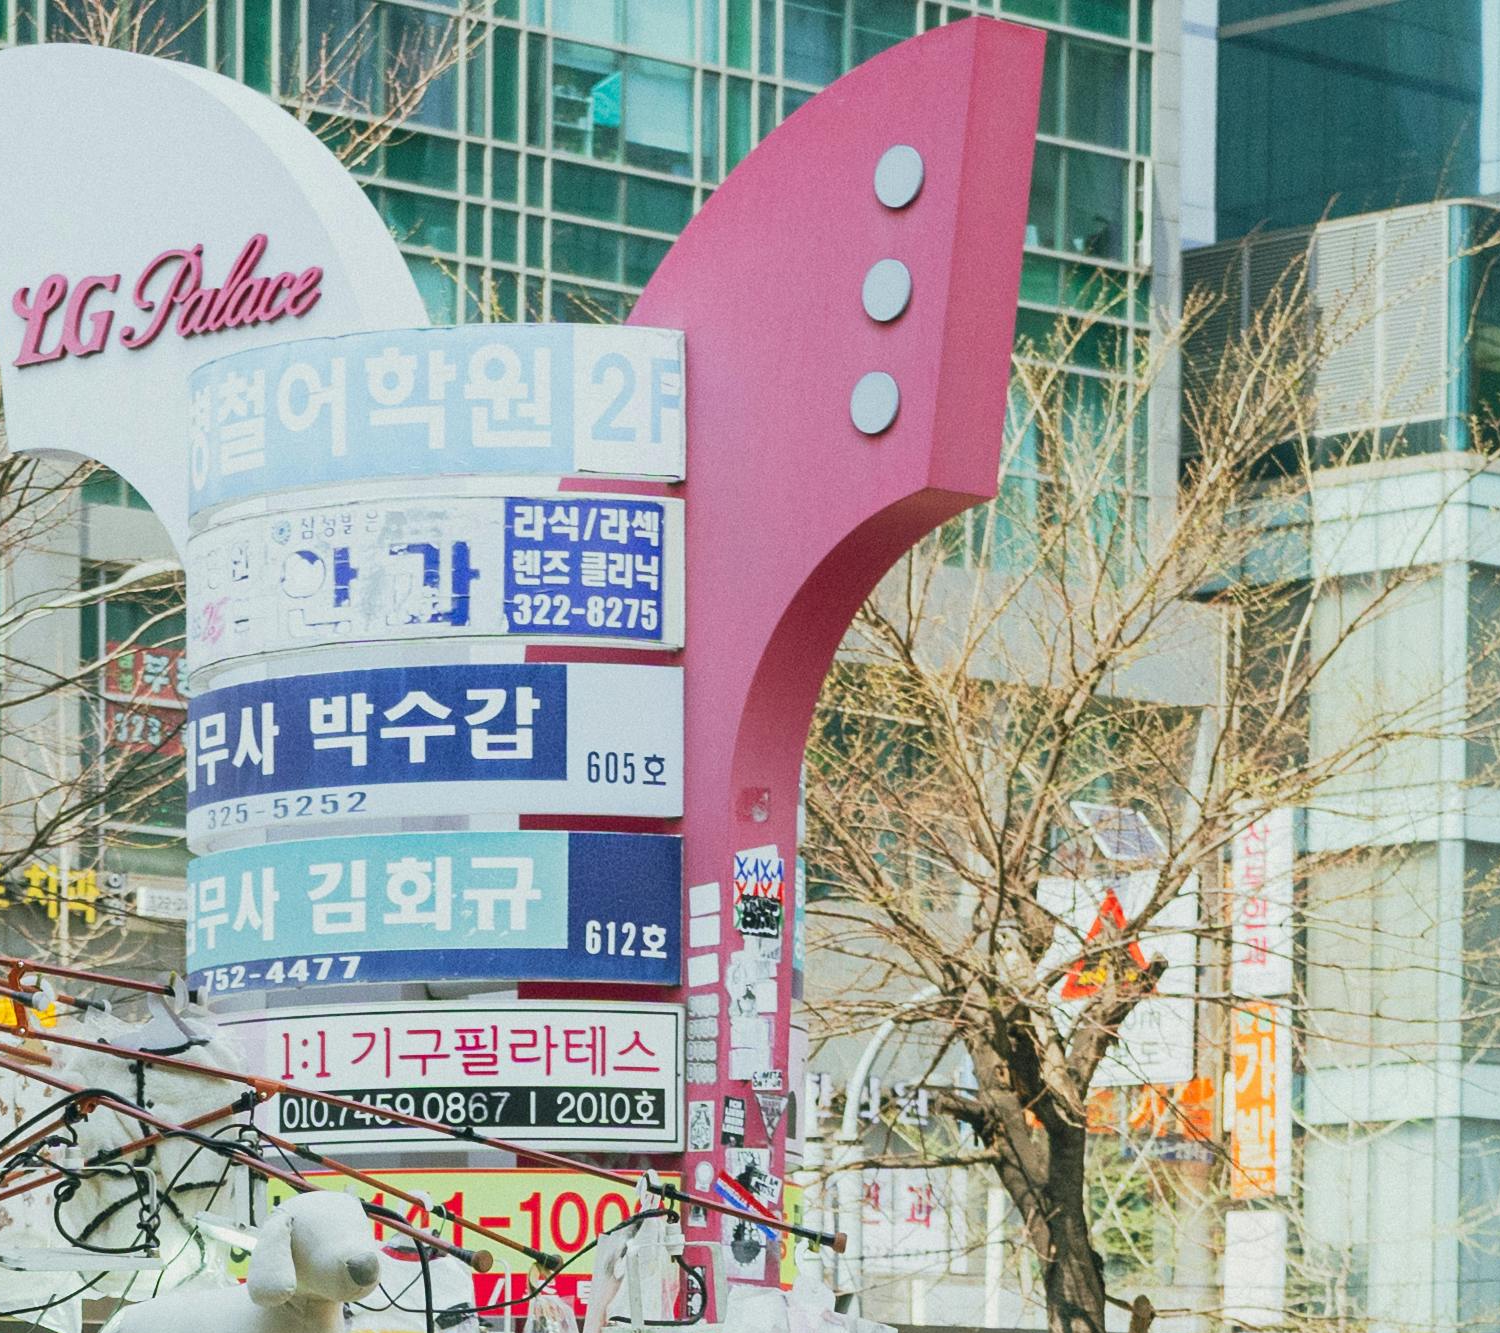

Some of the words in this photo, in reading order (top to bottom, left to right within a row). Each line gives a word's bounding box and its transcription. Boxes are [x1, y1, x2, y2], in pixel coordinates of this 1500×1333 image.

[10, 270, 122, 368] LG
[118, 232, 324, 349] Palace
[513, 505, 660, 547] 라식/라섹
[513, 549, 571, 588] 렌즈
[579, 548, 661, 592] 클리닉
[512, 594, 659, 632] 322-8275
[309, 684, 543, 774] 박수갑
[586, 749, 669, 787] 605호
[206, 791, 368, 831] 325-5252
[585, 920, 668, 961] 612호
[202, 955, 362, 993] 752-4477
[280, 1030, 330, 1081] 1:1
[350, 1024, 662, 1080] 기구필라테스
[555, 1090, 659, 1127] 2010호
